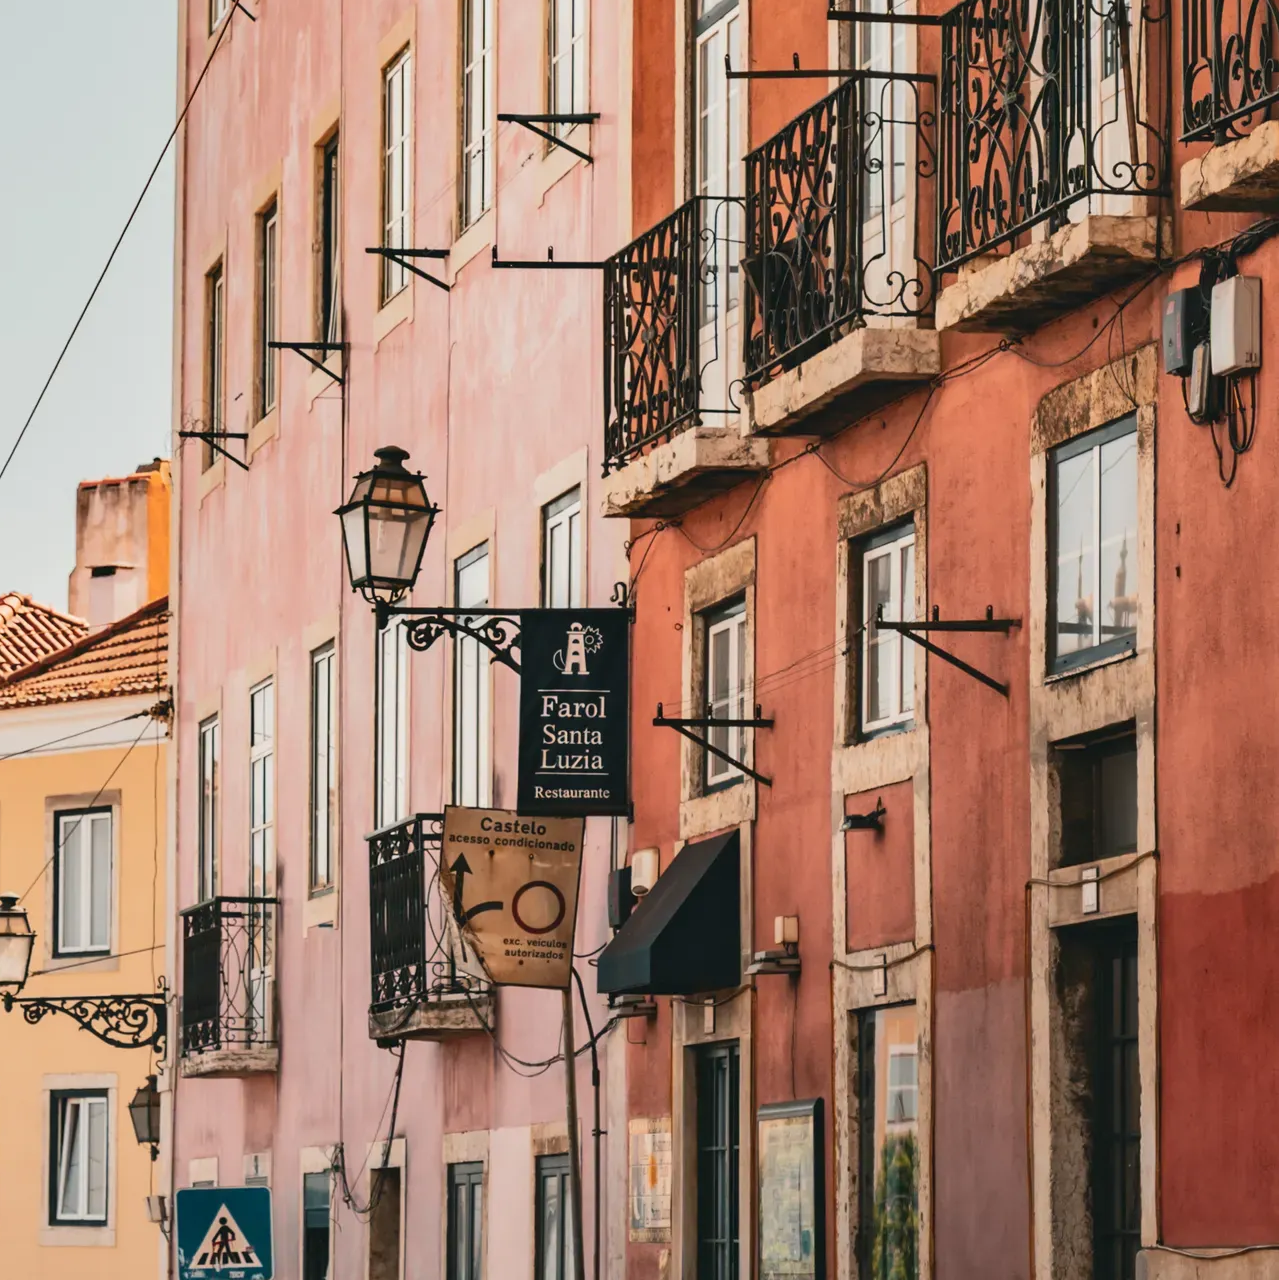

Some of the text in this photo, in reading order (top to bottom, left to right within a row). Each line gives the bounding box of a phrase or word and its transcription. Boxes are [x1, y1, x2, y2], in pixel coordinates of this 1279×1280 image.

[540, 696, 606, 719] Farol
[542, 724, 603, 745] Santa
[540, 748, 604, 770] Luzia
[534, 785, 610, 799] Restaurante
[480, 816, 547, 836] Castelo
[448, 834, 576, 853] acesso condicionado
[503, 937, 523, 947] exc.
[504, 948, 564, 960] autorizados
